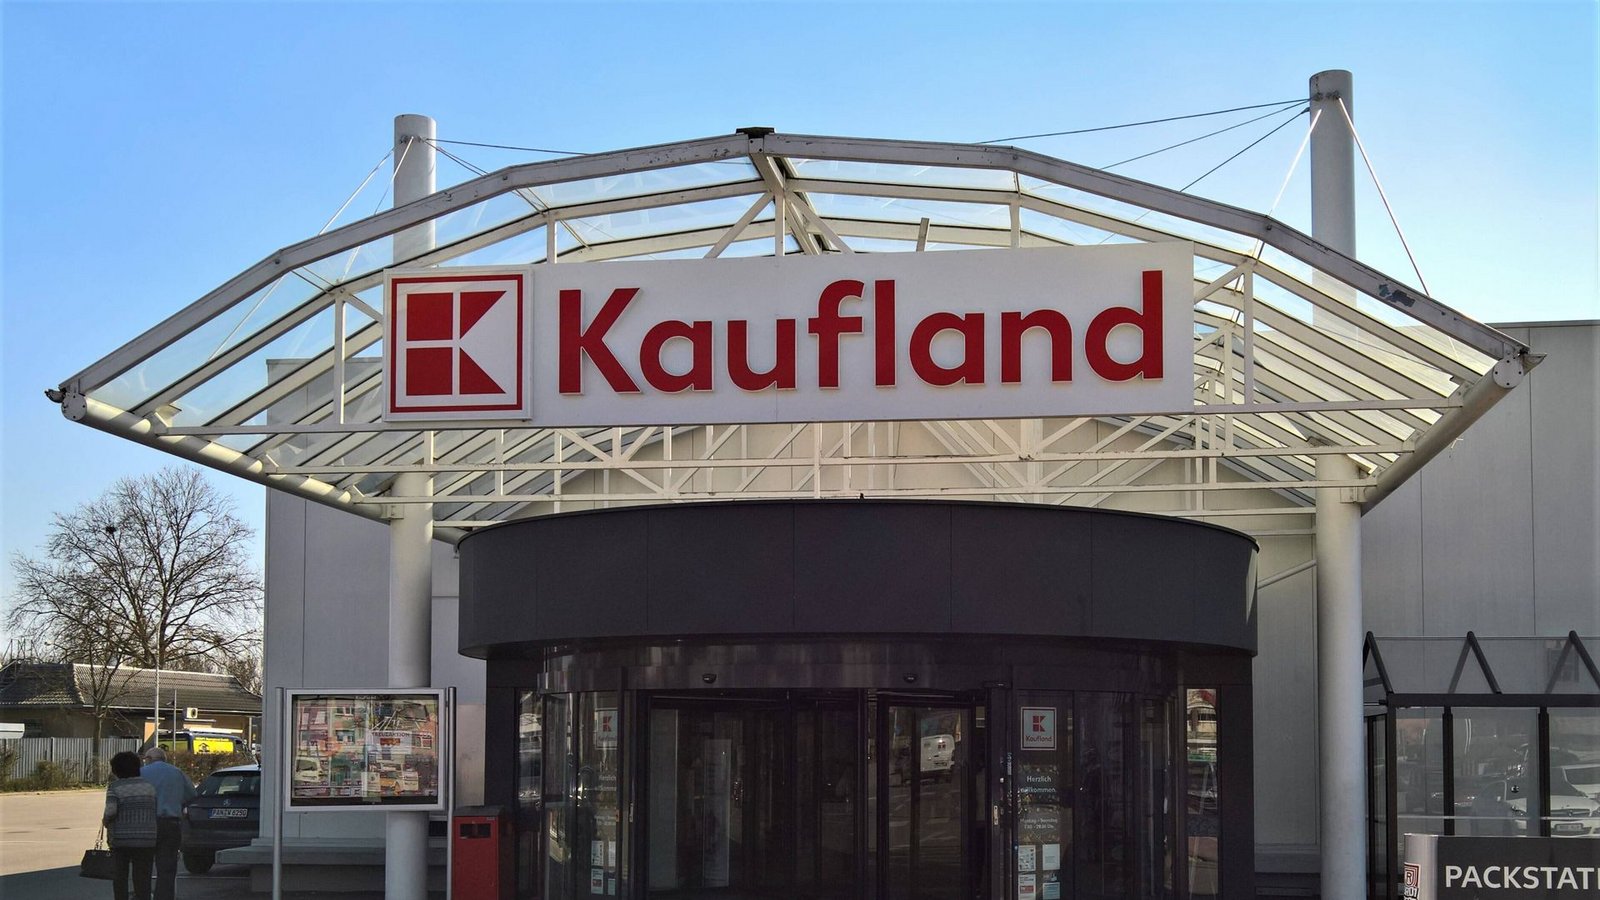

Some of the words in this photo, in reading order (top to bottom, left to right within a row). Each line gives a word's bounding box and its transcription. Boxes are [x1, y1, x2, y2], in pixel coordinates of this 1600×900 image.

[558, 269, 1165, 396] Kaufland
[1025, 735, 1052, 743] Kaufland
[1026, 775, 1052, 783] Herzlich
